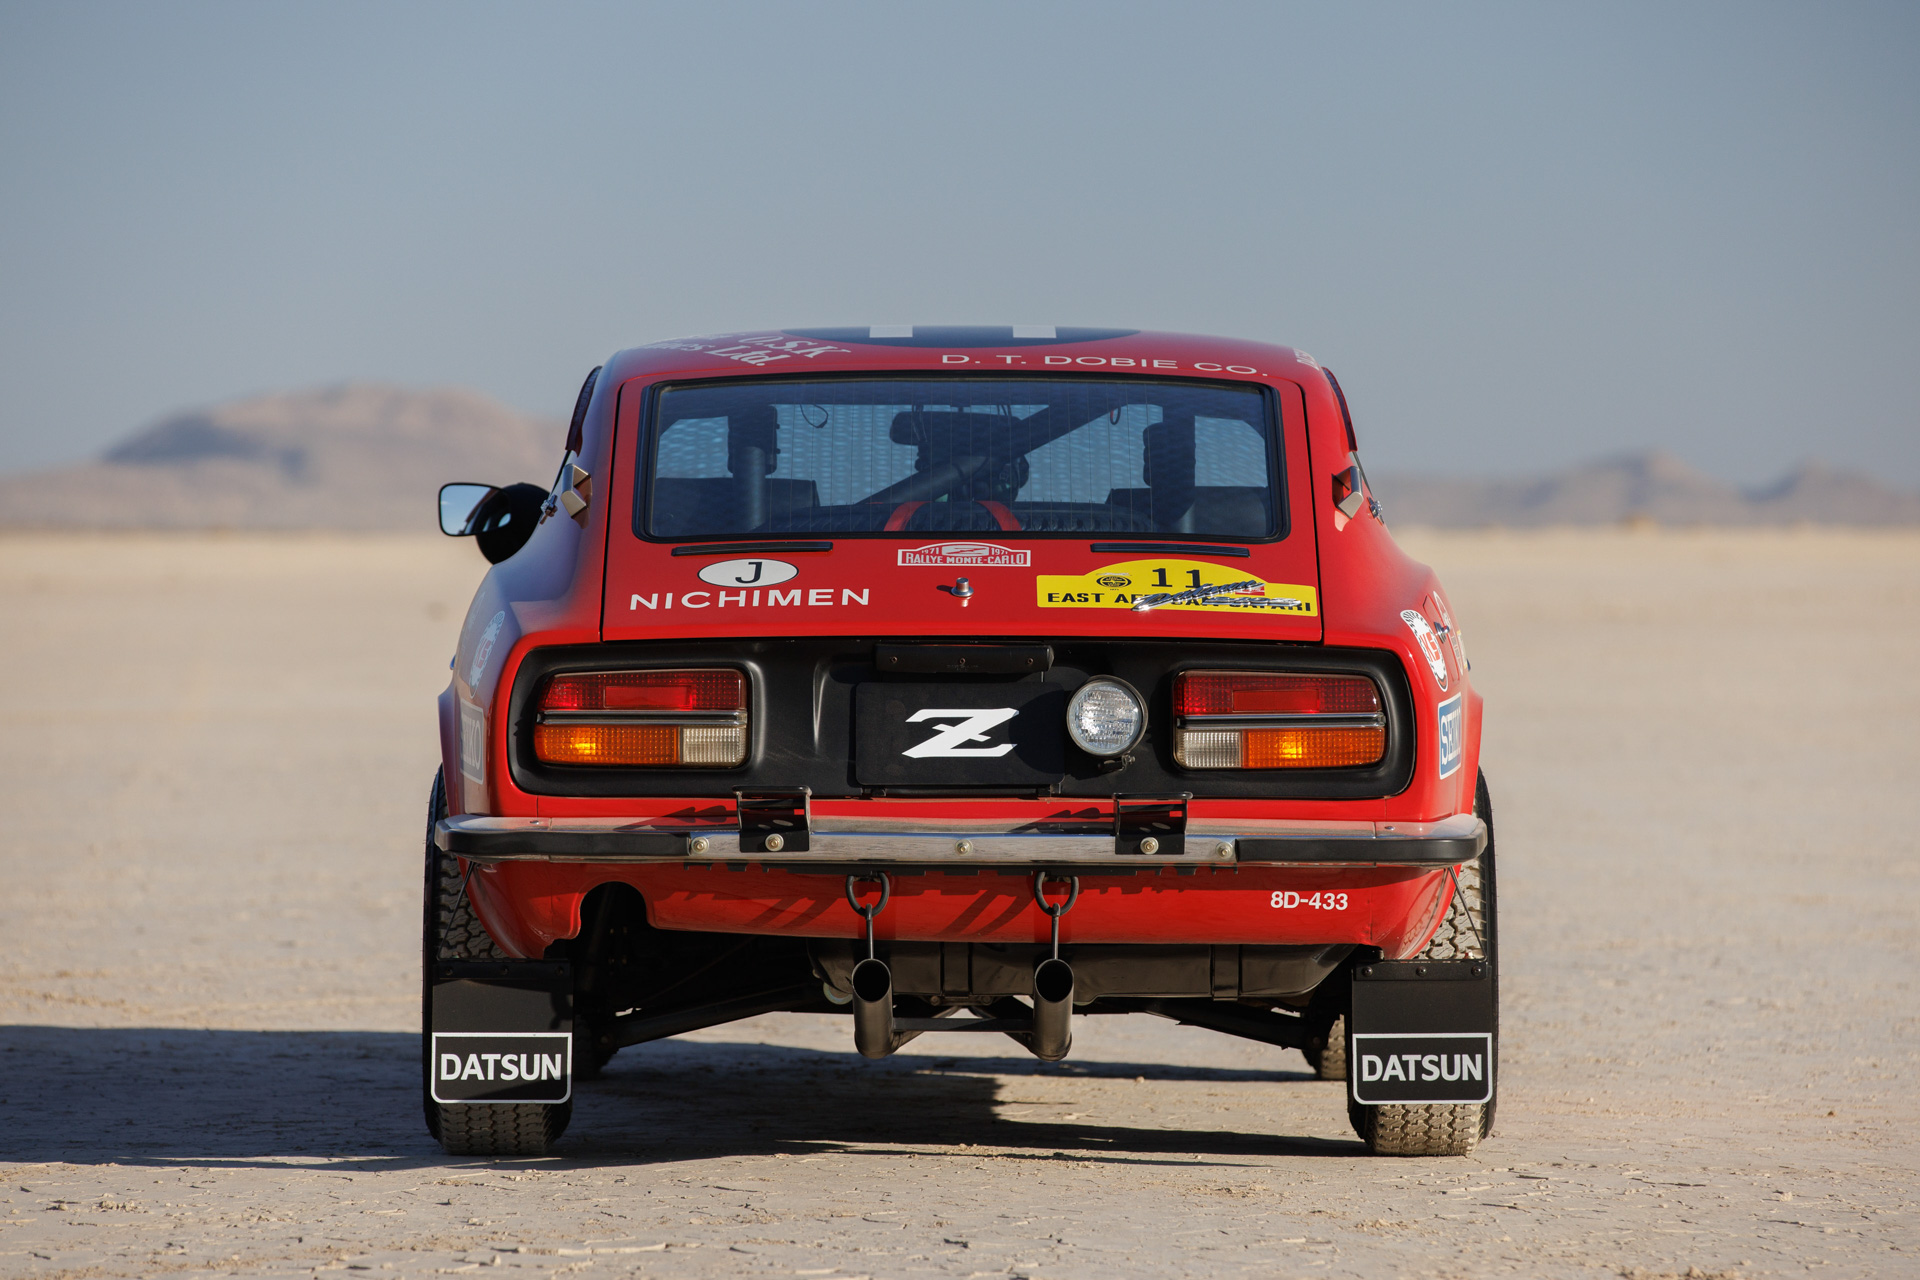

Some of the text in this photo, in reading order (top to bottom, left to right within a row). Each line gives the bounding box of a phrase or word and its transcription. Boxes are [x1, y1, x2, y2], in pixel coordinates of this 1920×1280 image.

[704, 345, 790, 366] Ltd.
[942, 354, 1268, 376] D. T. DOBIE CO.
[905, 552, 1024, 565] RALLYE MONTE-CARLO
[735, 561, 763, 584] J
[629, 588, 870, 611] NICHIMEN
[1048, 592, 1105, 603] EAST
[901, 707, 1020, 759] Z
[1270, 891, 1349, 911] 8D-433
[440, 1053, 562, 1081] DATSUN
[1361, 1054, 1483, 1082] DATSUN
